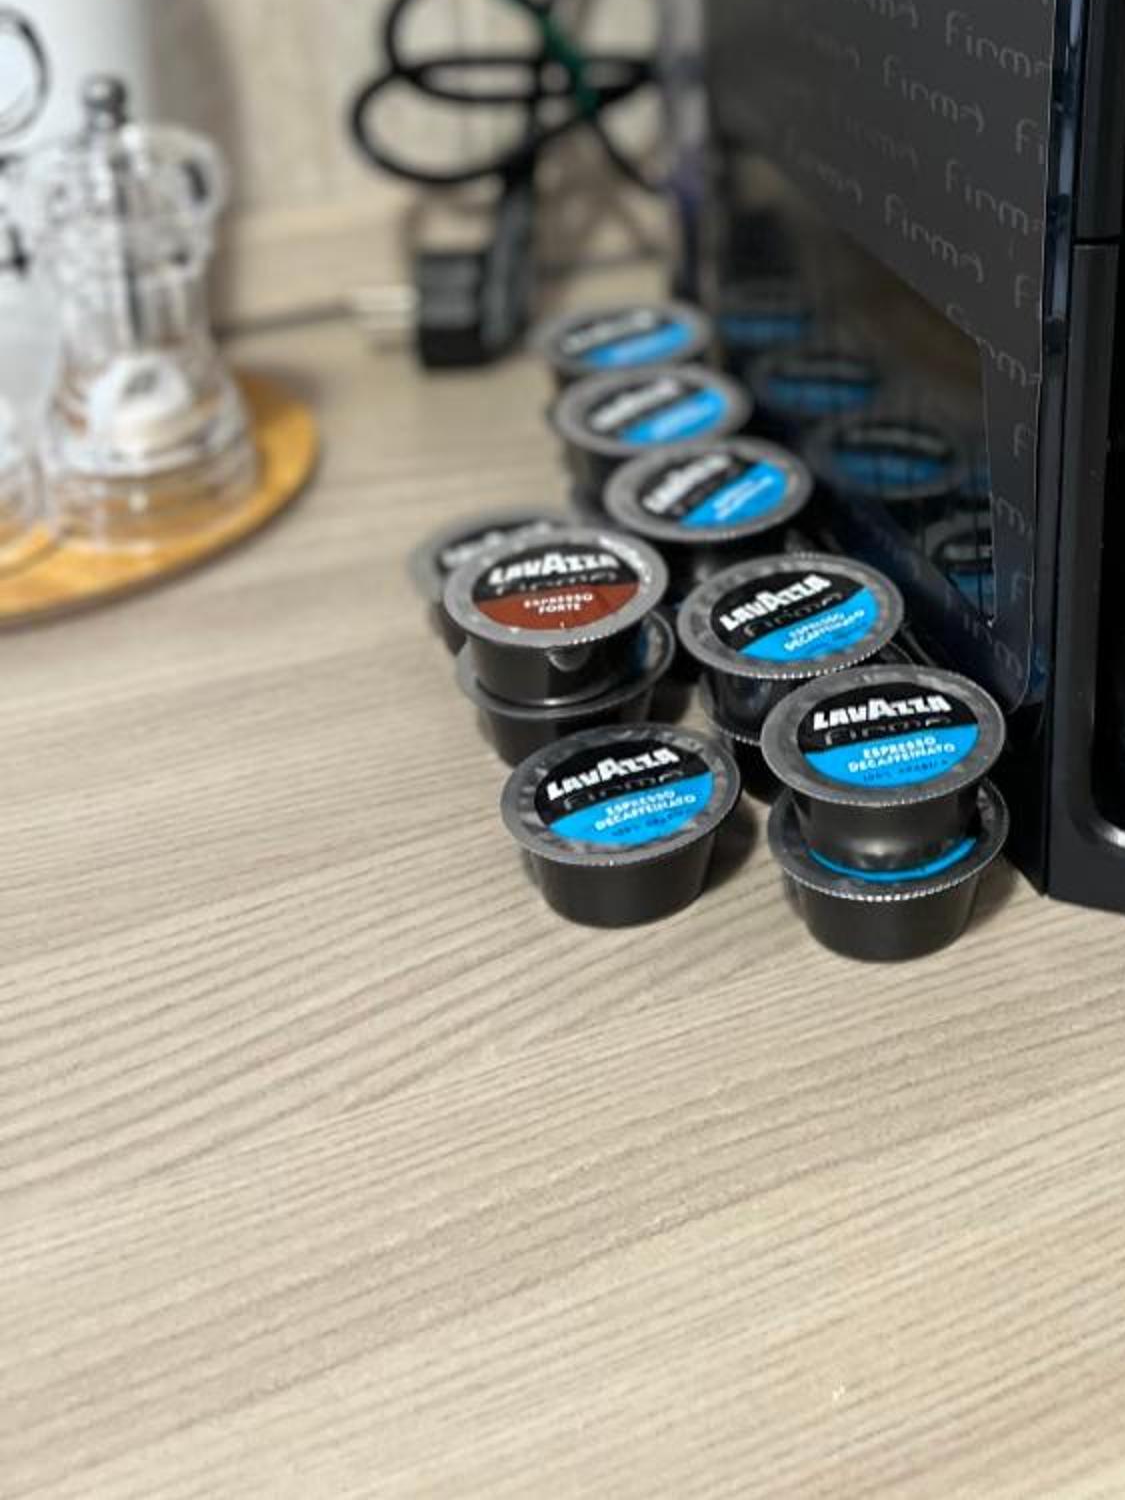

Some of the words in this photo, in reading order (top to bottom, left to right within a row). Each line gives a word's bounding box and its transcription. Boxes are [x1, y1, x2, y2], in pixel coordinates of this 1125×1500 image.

[488, 552, 620, 587] LAVAZZA
[720, 574, 832, 631] LAVAZZA
[813, 694, 952, 731] LAVAZZA
[547, 747, 680, 800] LAVAZZA
